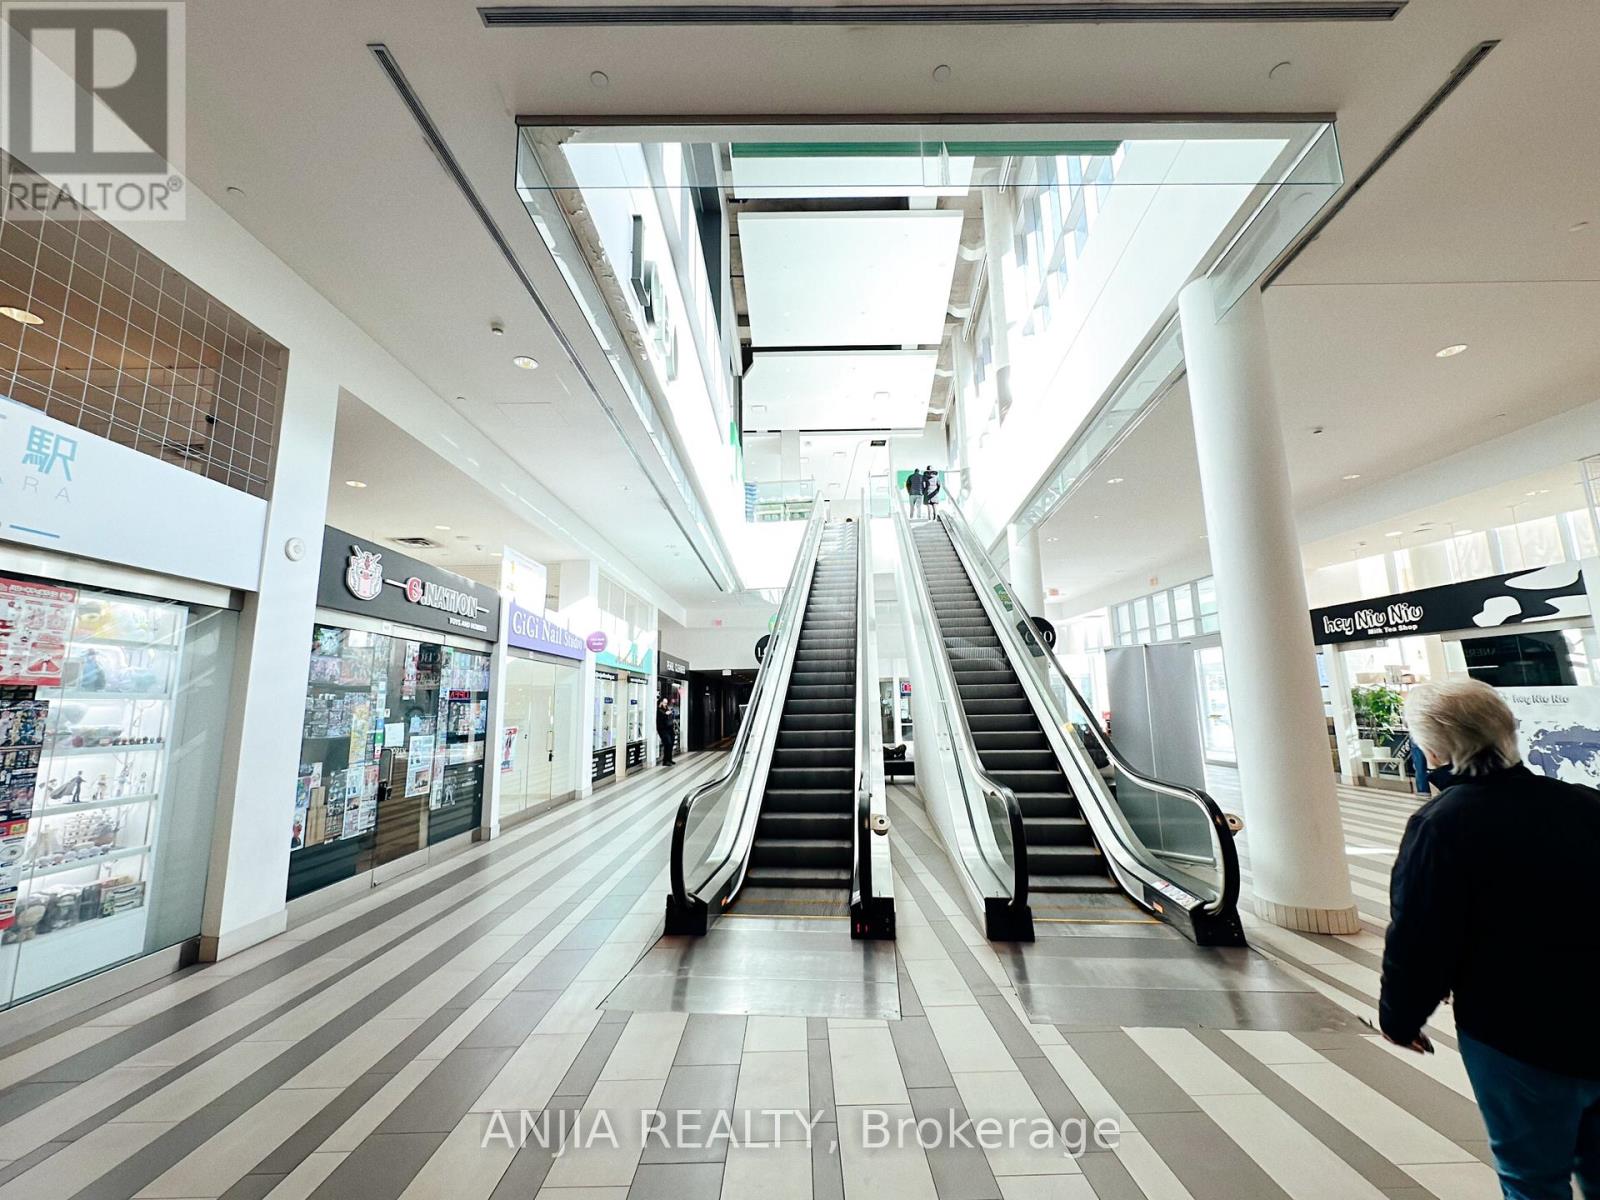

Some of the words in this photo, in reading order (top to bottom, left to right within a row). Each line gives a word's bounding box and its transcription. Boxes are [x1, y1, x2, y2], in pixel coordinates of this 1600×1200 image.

[512, 610, 539, 640] GiGi
[542, 619, 562, 645] Nail
[1322, 615, 1354, 636] hey
[1354, 608, 1387, 630] Niu
[1387, 602, 1424, 626] Niu
[1367, 627, 1383, 635] Milk
[1384, 626, 1397, 634] Tea
[1398, 624, 1418, 632] Shop
